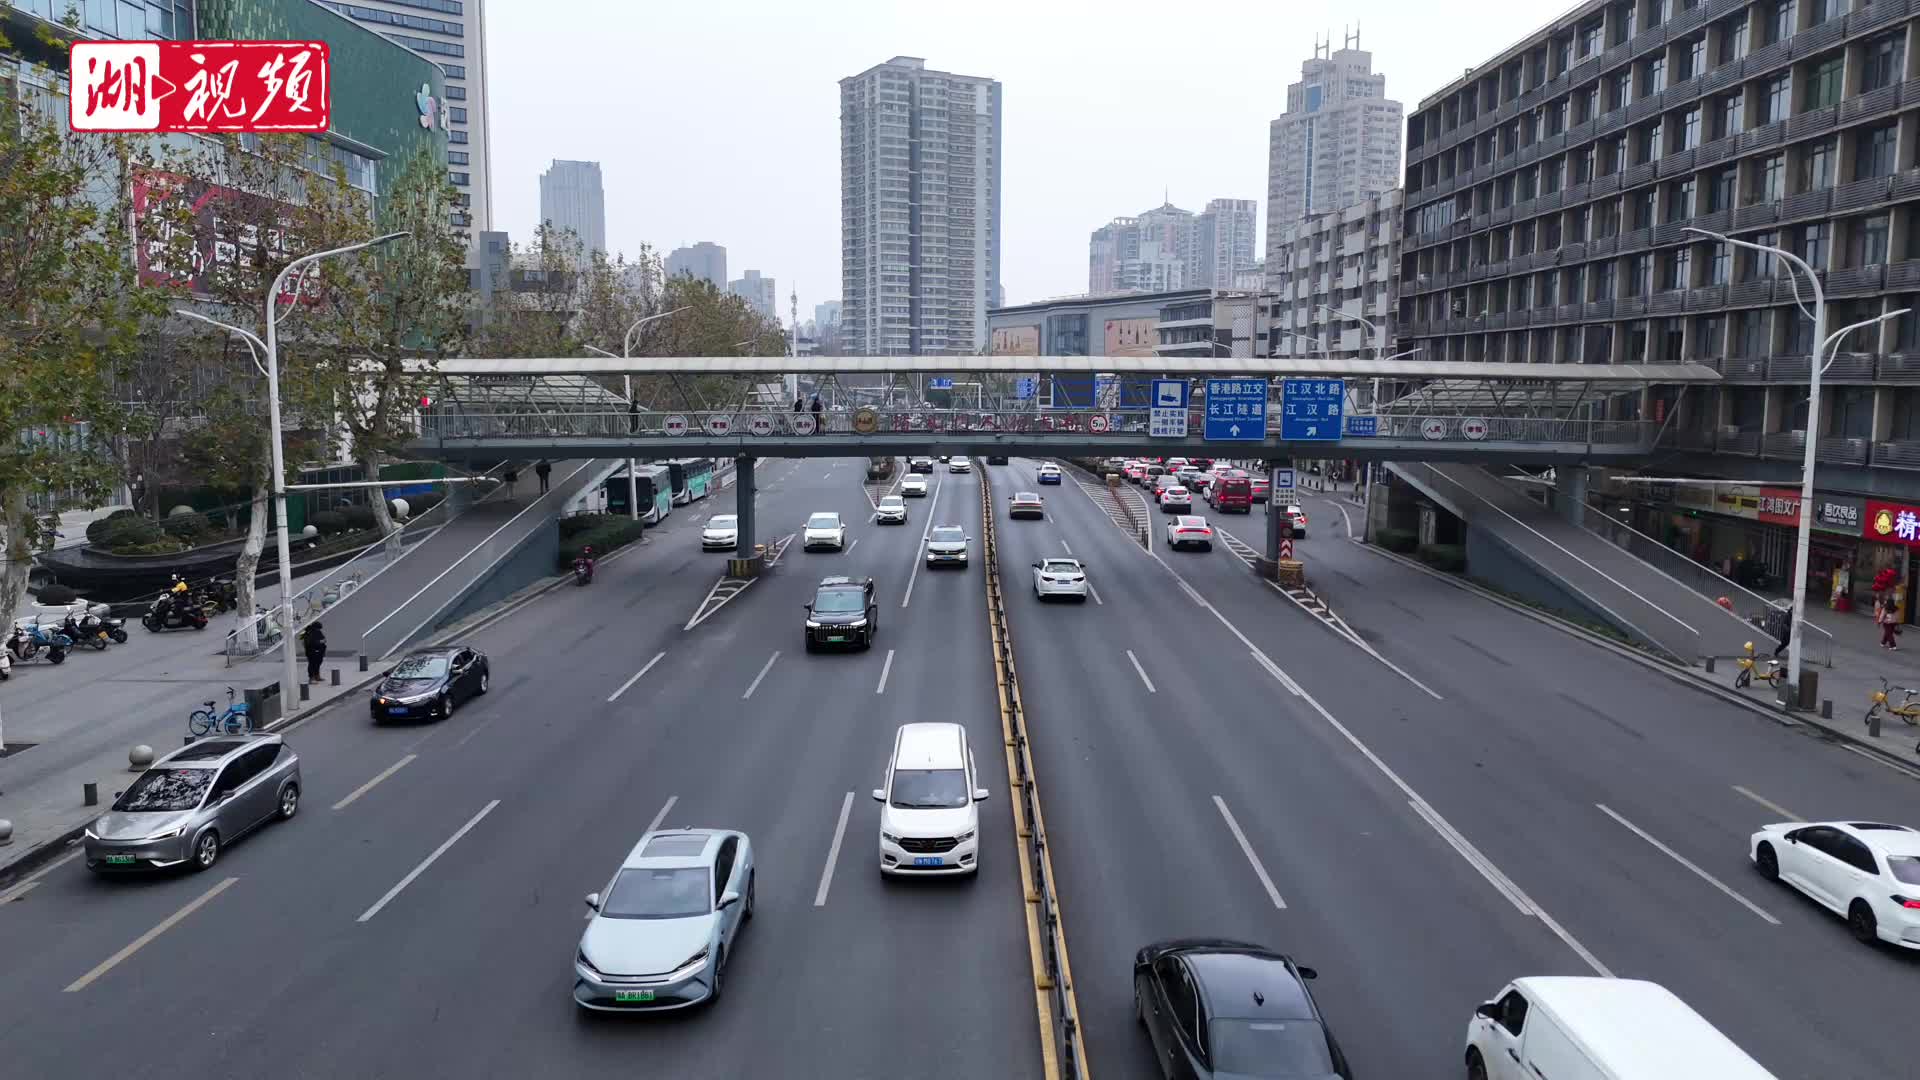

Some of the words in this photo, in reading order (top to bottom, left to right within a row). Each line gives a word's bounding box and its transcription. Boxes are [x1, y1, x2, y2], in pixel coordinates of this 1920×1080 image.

[1210, 383, 1263, 395] 香港路立交
[1286, 383, 1340, 395] 江汉北路
[1209, 403, 1263, 415] 长江隧道
[1286, 404, 1339, 415] 江汉路
[1092, 420, 1105, 429] 5m
[1894, 510, 1920, 541] 精
